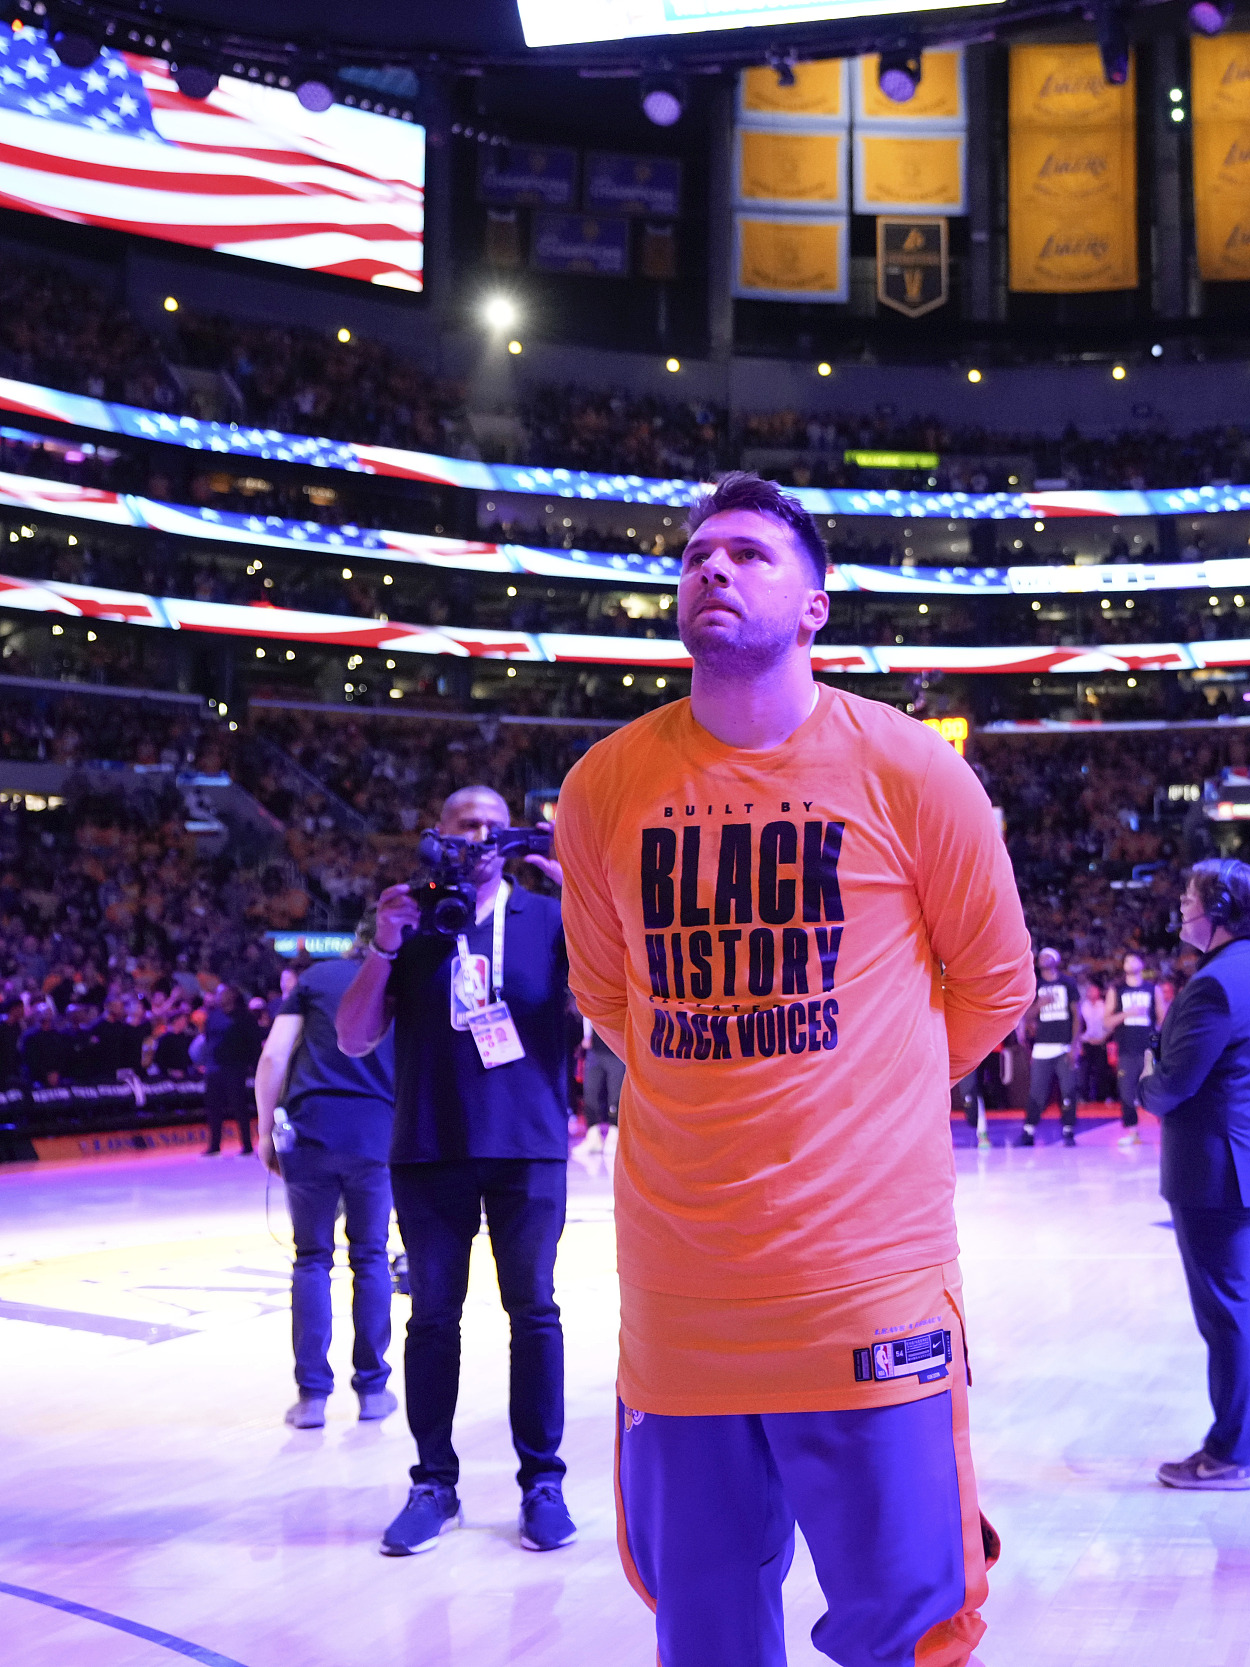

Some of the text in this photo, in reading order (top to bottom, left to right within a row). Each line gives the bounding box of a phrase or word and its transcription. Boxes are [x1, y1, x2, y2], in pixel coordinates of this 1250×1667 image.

[664, 801, 813, 818] BUILT BY
[641, 820, 845, 929] BLACK
[645, 926, 844, 999] HISTORY
[650, 998, 839, 1060] BLACK VOICES
